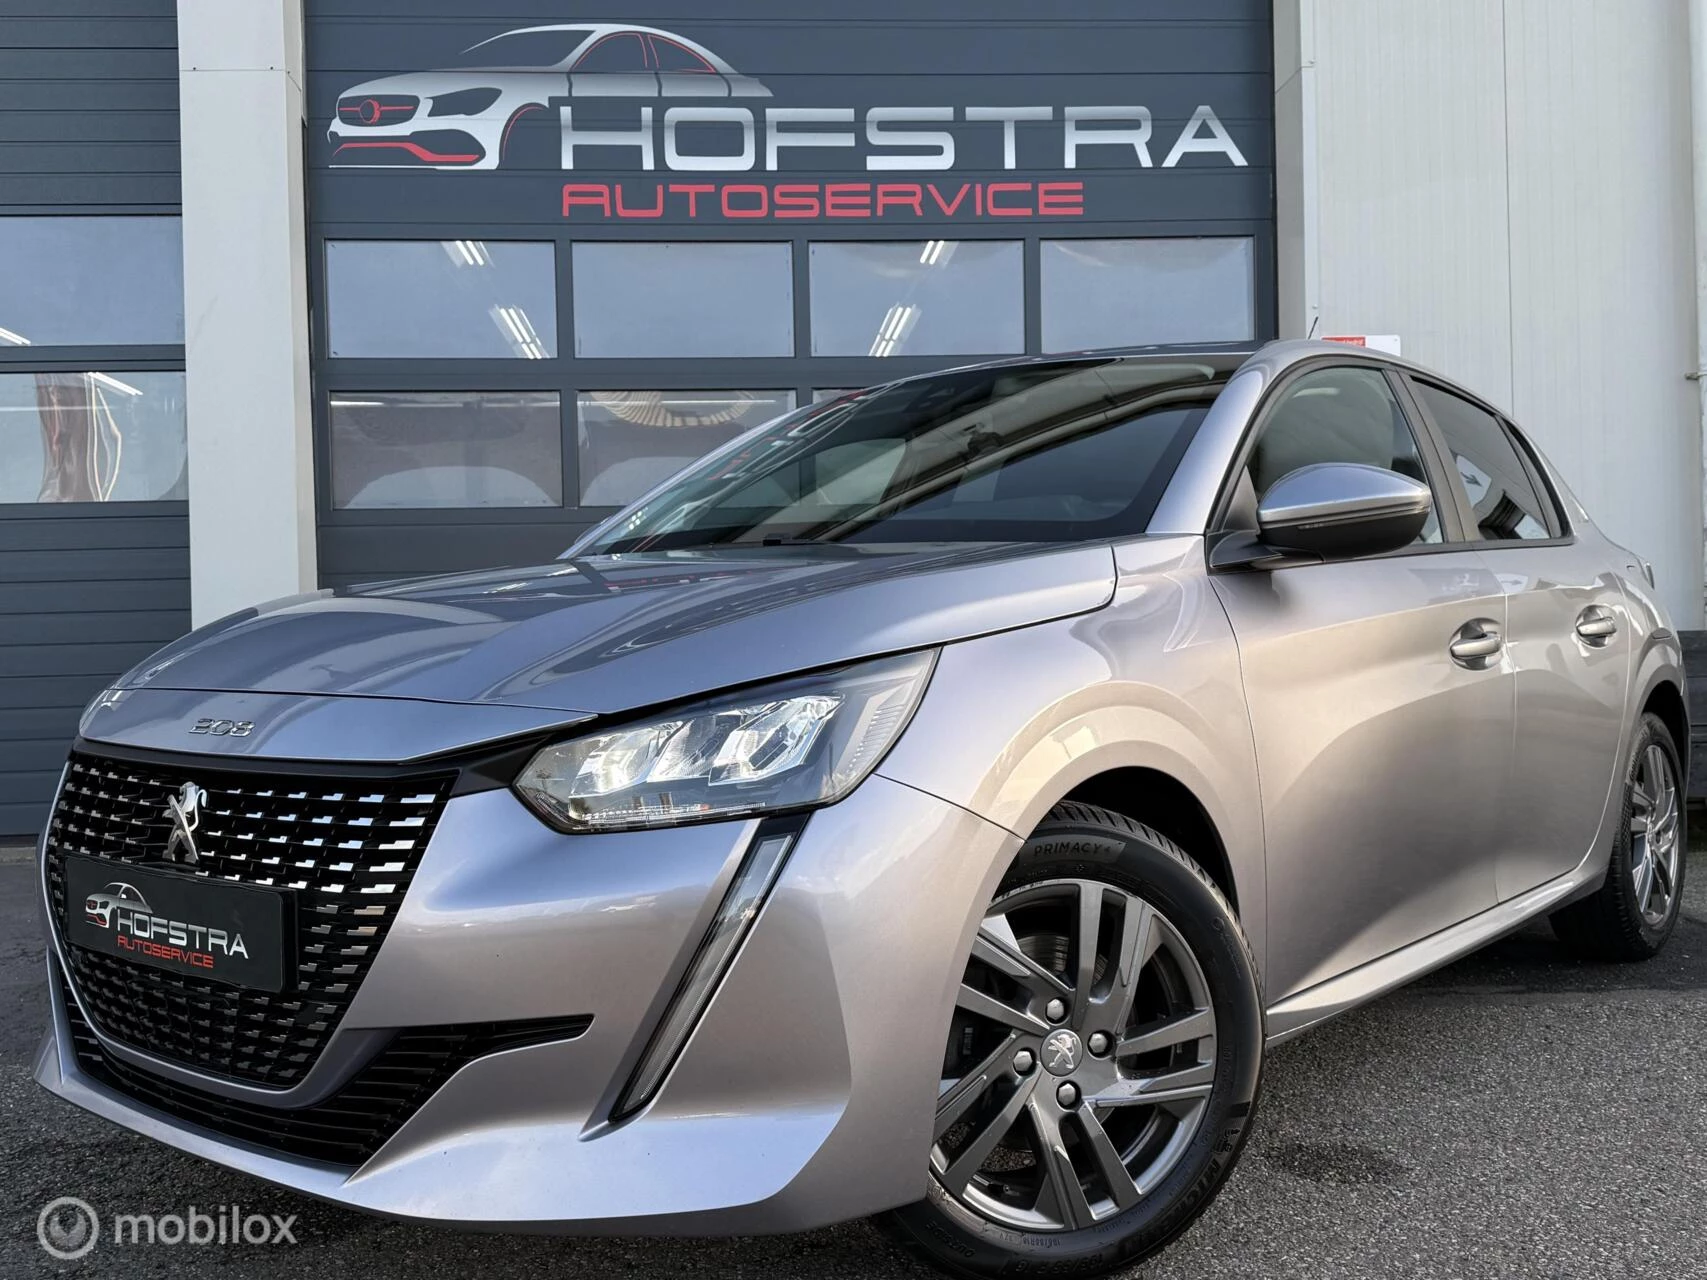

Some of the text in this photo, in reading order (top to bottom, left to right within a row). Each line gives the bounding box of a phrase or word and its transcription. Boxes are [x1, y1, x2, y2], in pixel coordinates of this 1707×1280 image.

[561, 105, 1248, 171] HOFSTRA
[561, 182, 1084, 219] AUTOSERVICE
[188, 718, 256, 738] 208
[1034, 842, 1102, 857] PRIMACY
[117, 909, 249, 960] HOFSTRA
[117, 935, 214, 969] AUTOSERVICE
